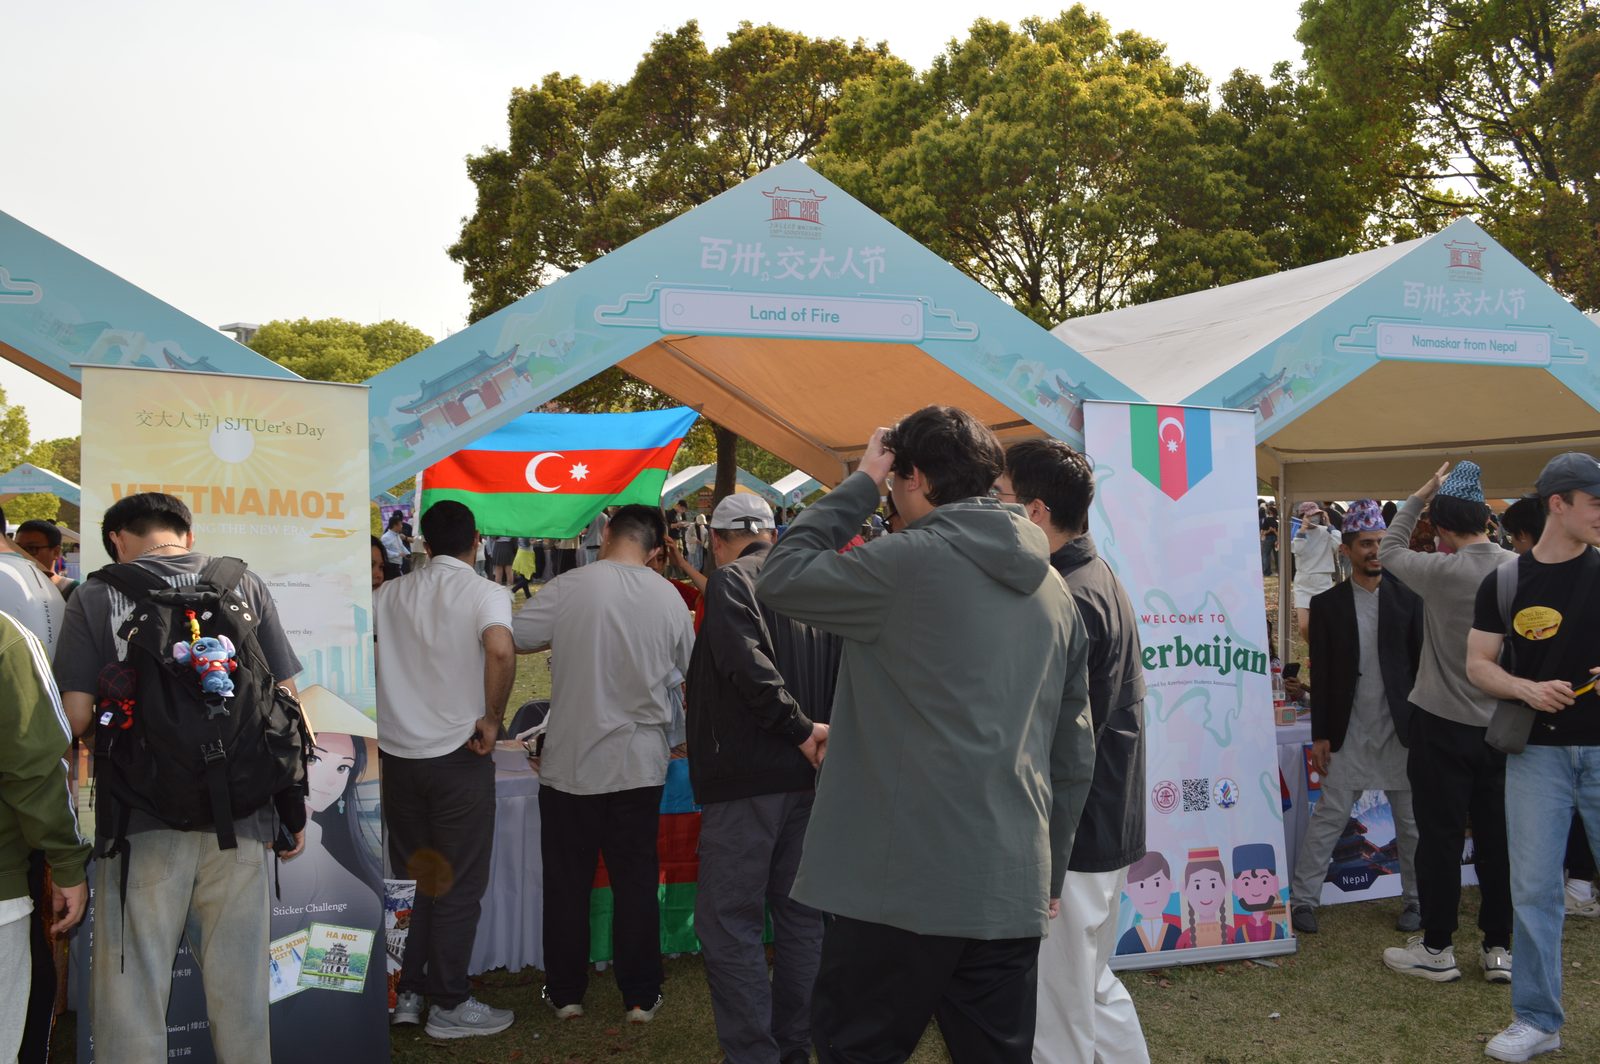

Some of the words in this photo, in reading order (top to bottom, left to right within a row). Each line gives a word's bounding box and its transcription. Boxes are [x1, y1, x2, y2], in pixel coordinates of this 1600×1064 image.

[750, 305, 786, 321] Land
[791, 306, 807, 322] of
[811, 307, 840, 324] Fire
[1412, 335, 1460, 349] Namaskar
[1463, 338, 1487, 350] from
[1490, 340, 1517, 354] Nepal
[135, 409, 211, 429] 交大人节
[296, 422, 325, 440] Day
[220, 523, 247, 535] THE
[250, 524, 279, 536] NEW
[1141, 614, 1204, 624] WELCOME
[1210, 614, 1225, 623] TO
[1141, 634, 1267, 676] erbaijan
[1342, 873, 1368, 885] Nepal
[273, 906, 304, 916] Sticker
[305, 902, 347, 913] Challenge
[325, 931, 338, 939] HA
[341, 933, 358, 941] NOI
